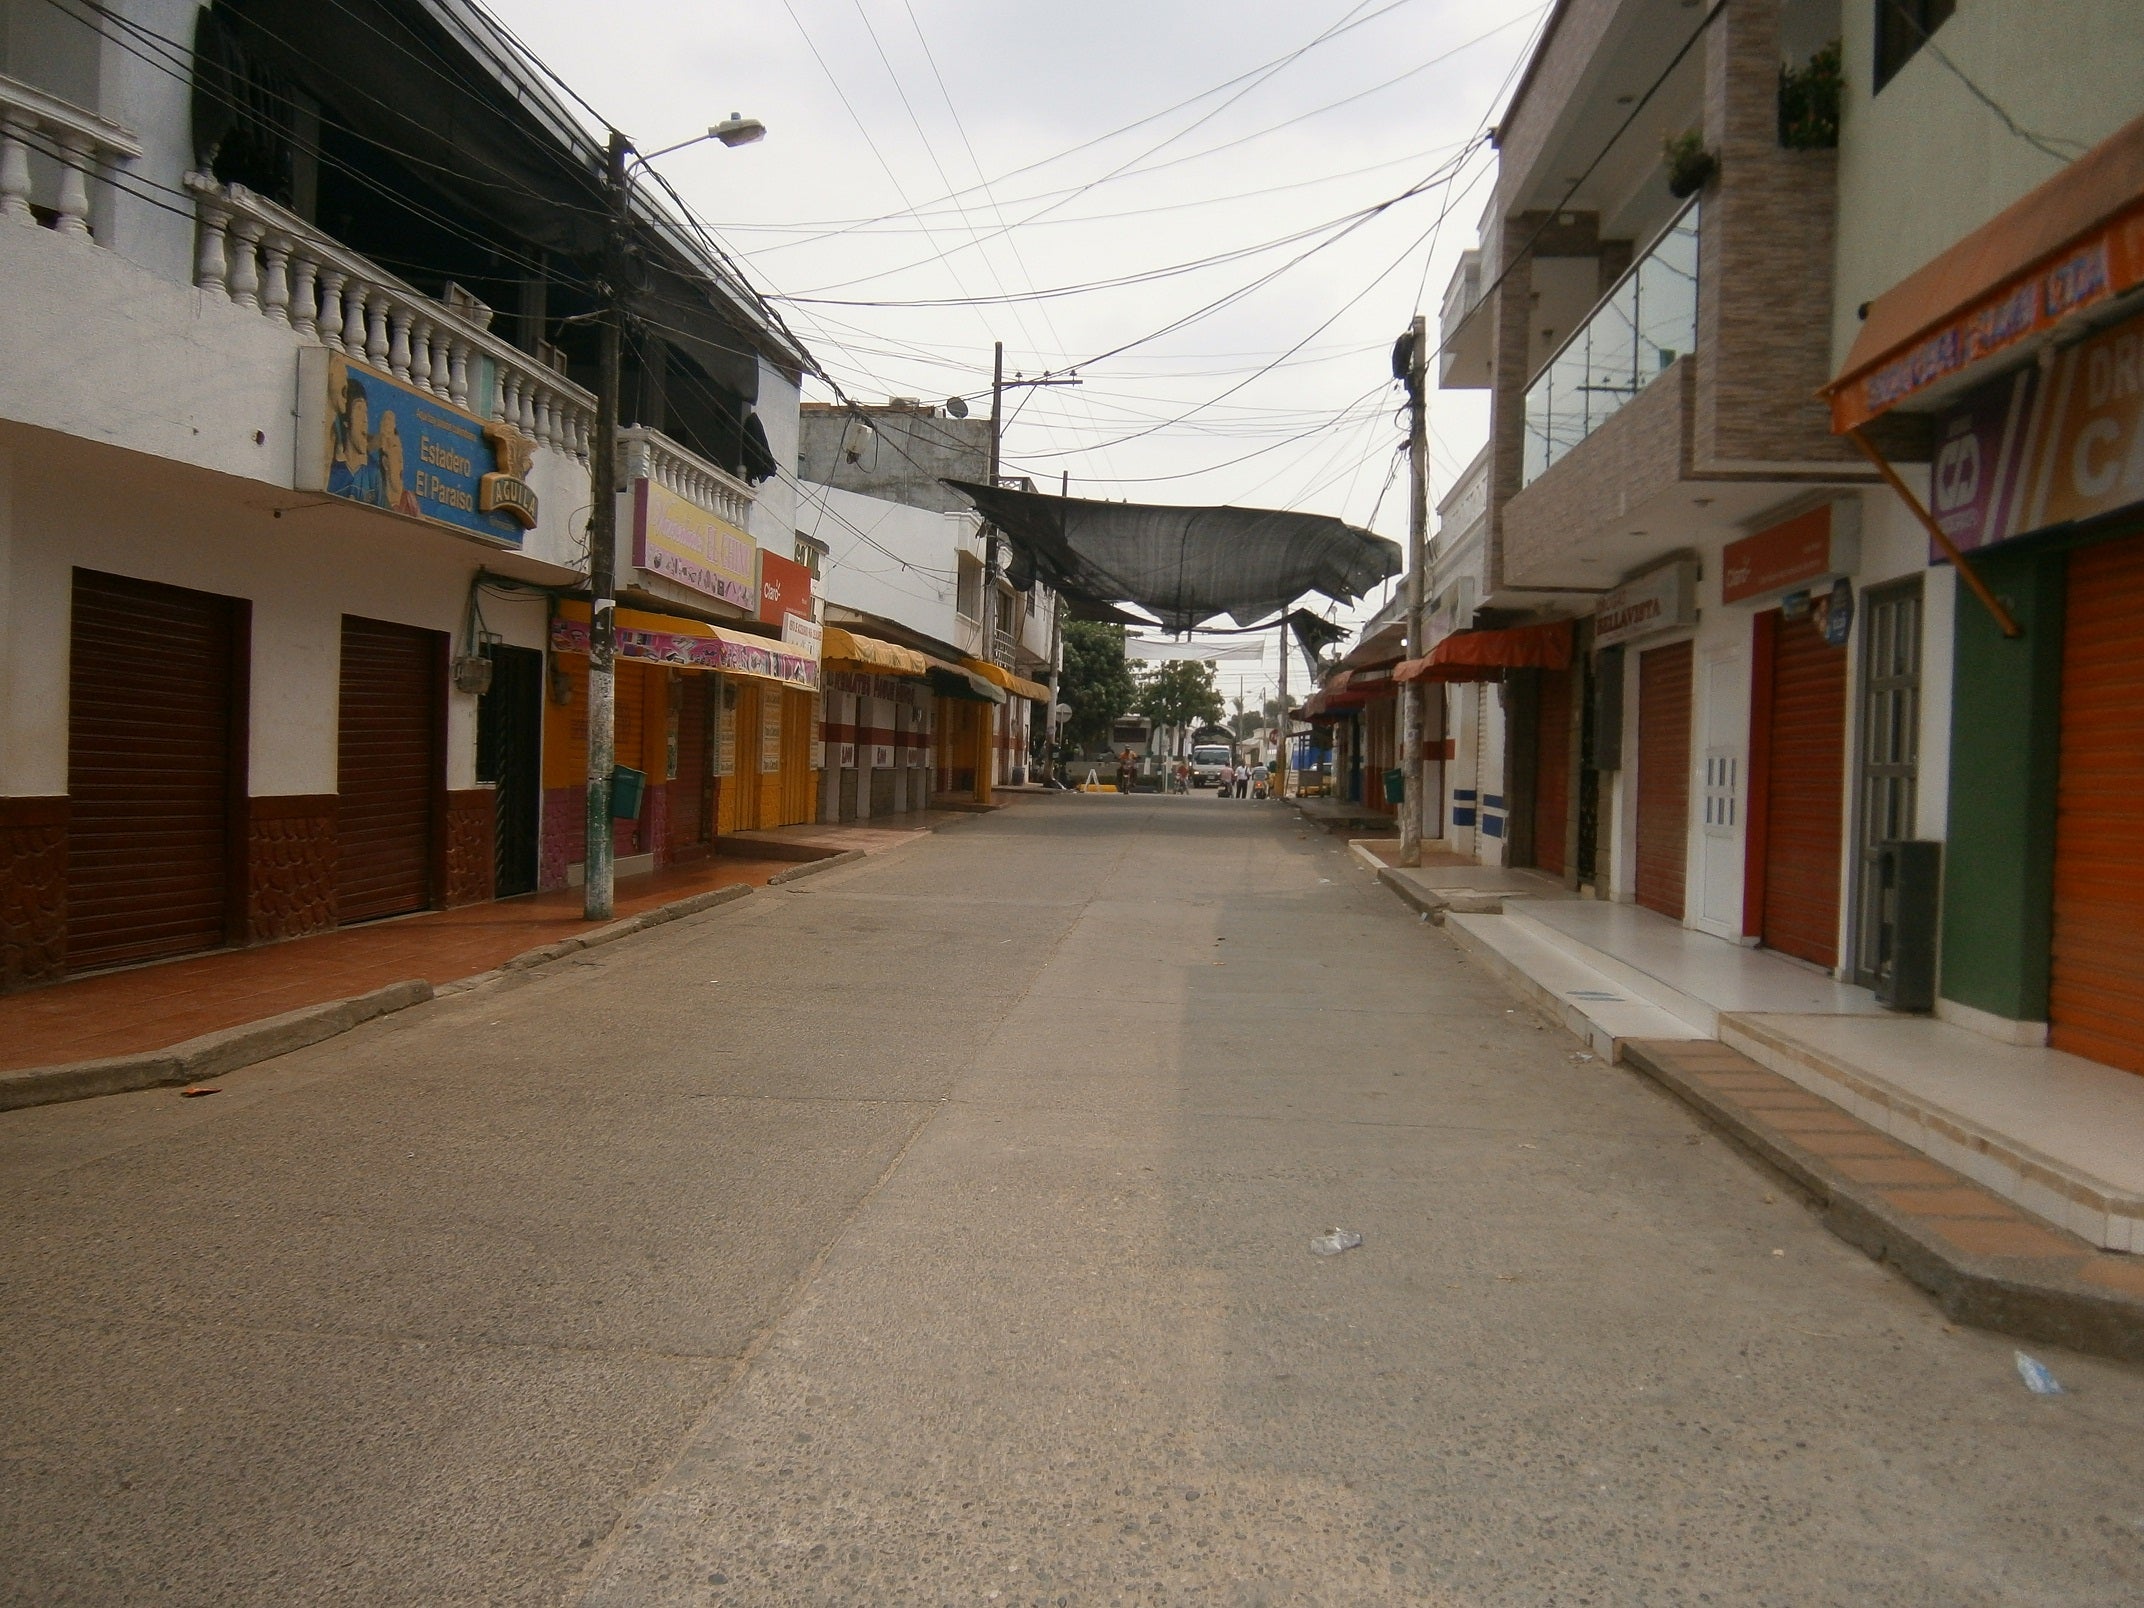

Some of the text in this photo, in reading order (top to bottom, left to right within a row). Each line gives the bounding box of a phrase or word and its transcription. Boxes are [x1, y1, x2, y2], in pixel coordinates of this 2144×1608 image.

[420, 435, 472, 479] Estadero
[415, 470, 428, 497] El
[763, 581, 779, 602] Claro
[1596, 598, 1661, 636] BELLAVISTA
